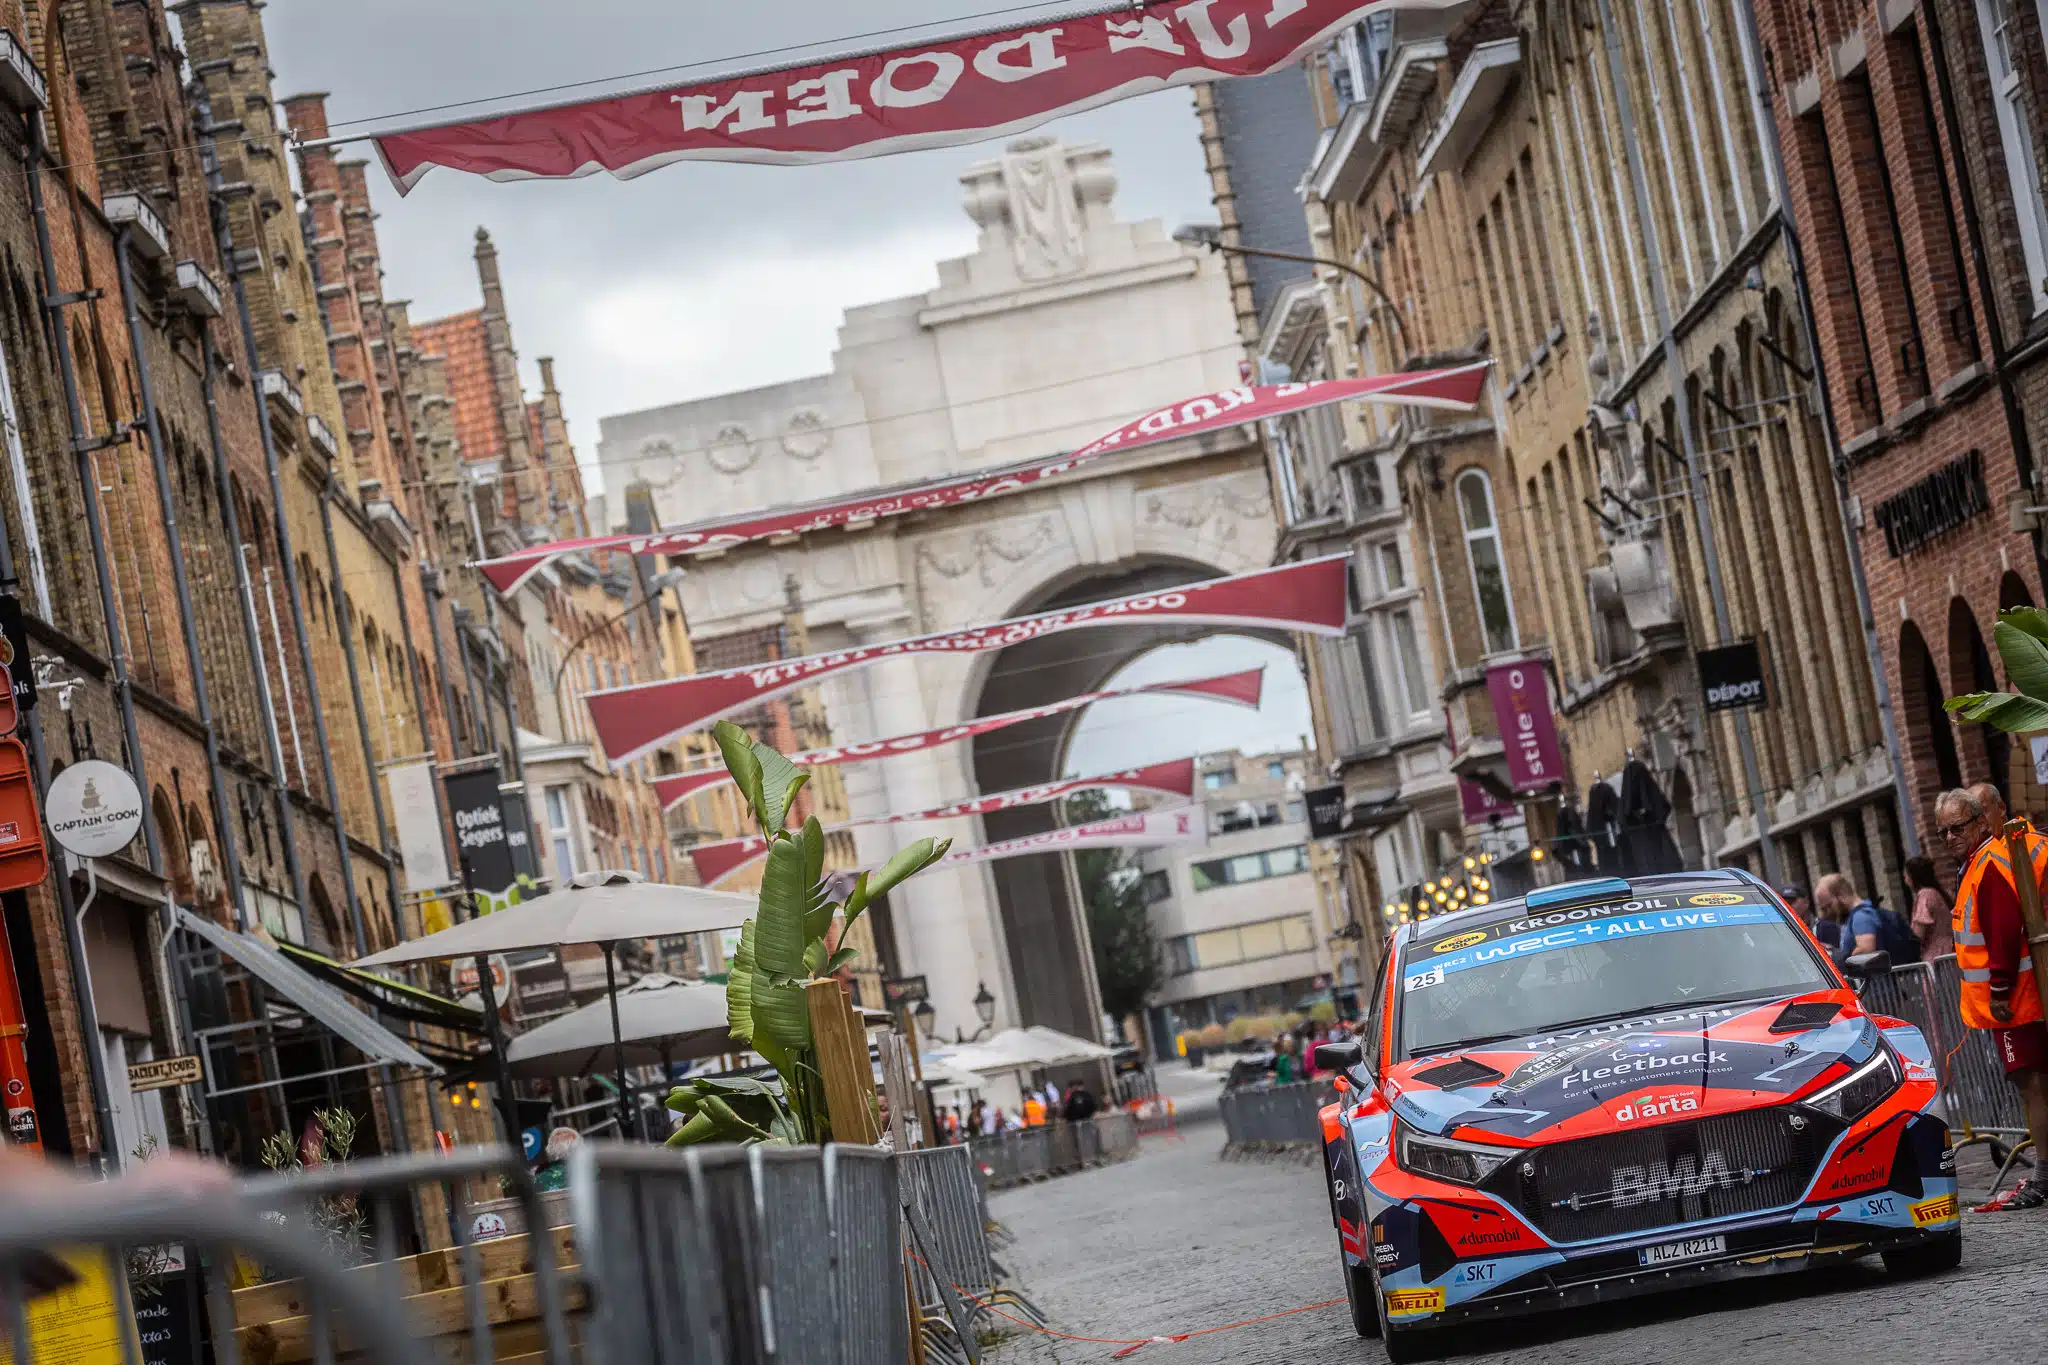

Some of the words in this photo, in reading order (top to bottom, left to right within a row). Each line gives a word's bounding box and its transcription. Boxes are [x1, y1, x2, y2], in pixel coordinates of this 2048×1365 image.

[53, 814, 103, 833] CAPTAIN
[106, 807, 140, 823] COOK
[455, 804, 501, 830] Optiek
[458, 825, 505, 848] Segers
[1508, 898, 1668, 933] KROON-OIL
[1606, 918, 1655, 936] ALL
[1660, 912, 1718, 927] LIVE
[1412, 972, 1437, 989] 25
[166, 1058, 197, 1076] TOURS
[1562, 1050, 1729, 1090] Fleetback
[1563, 1090, 1580, 1099] Car
[1582, 1081, 1618, 1095] dealers
[1629, 1068, 1681, 1083] customers
[1683, 1065, 1733, 1075] connected
[1612, 1149, 1735, 1209] BMA
[1840, 1164, 1885, 1189] dumobil
[1867, 1197, 1895, 1215] SKT
[1467, 1227, 1521, 1245] dumobil
[1653, 1241, 1680, 1261] ALZ
[1683, 1237, 1719, 1257] R211
[1466, 1263, 1497, 1282] SKT
